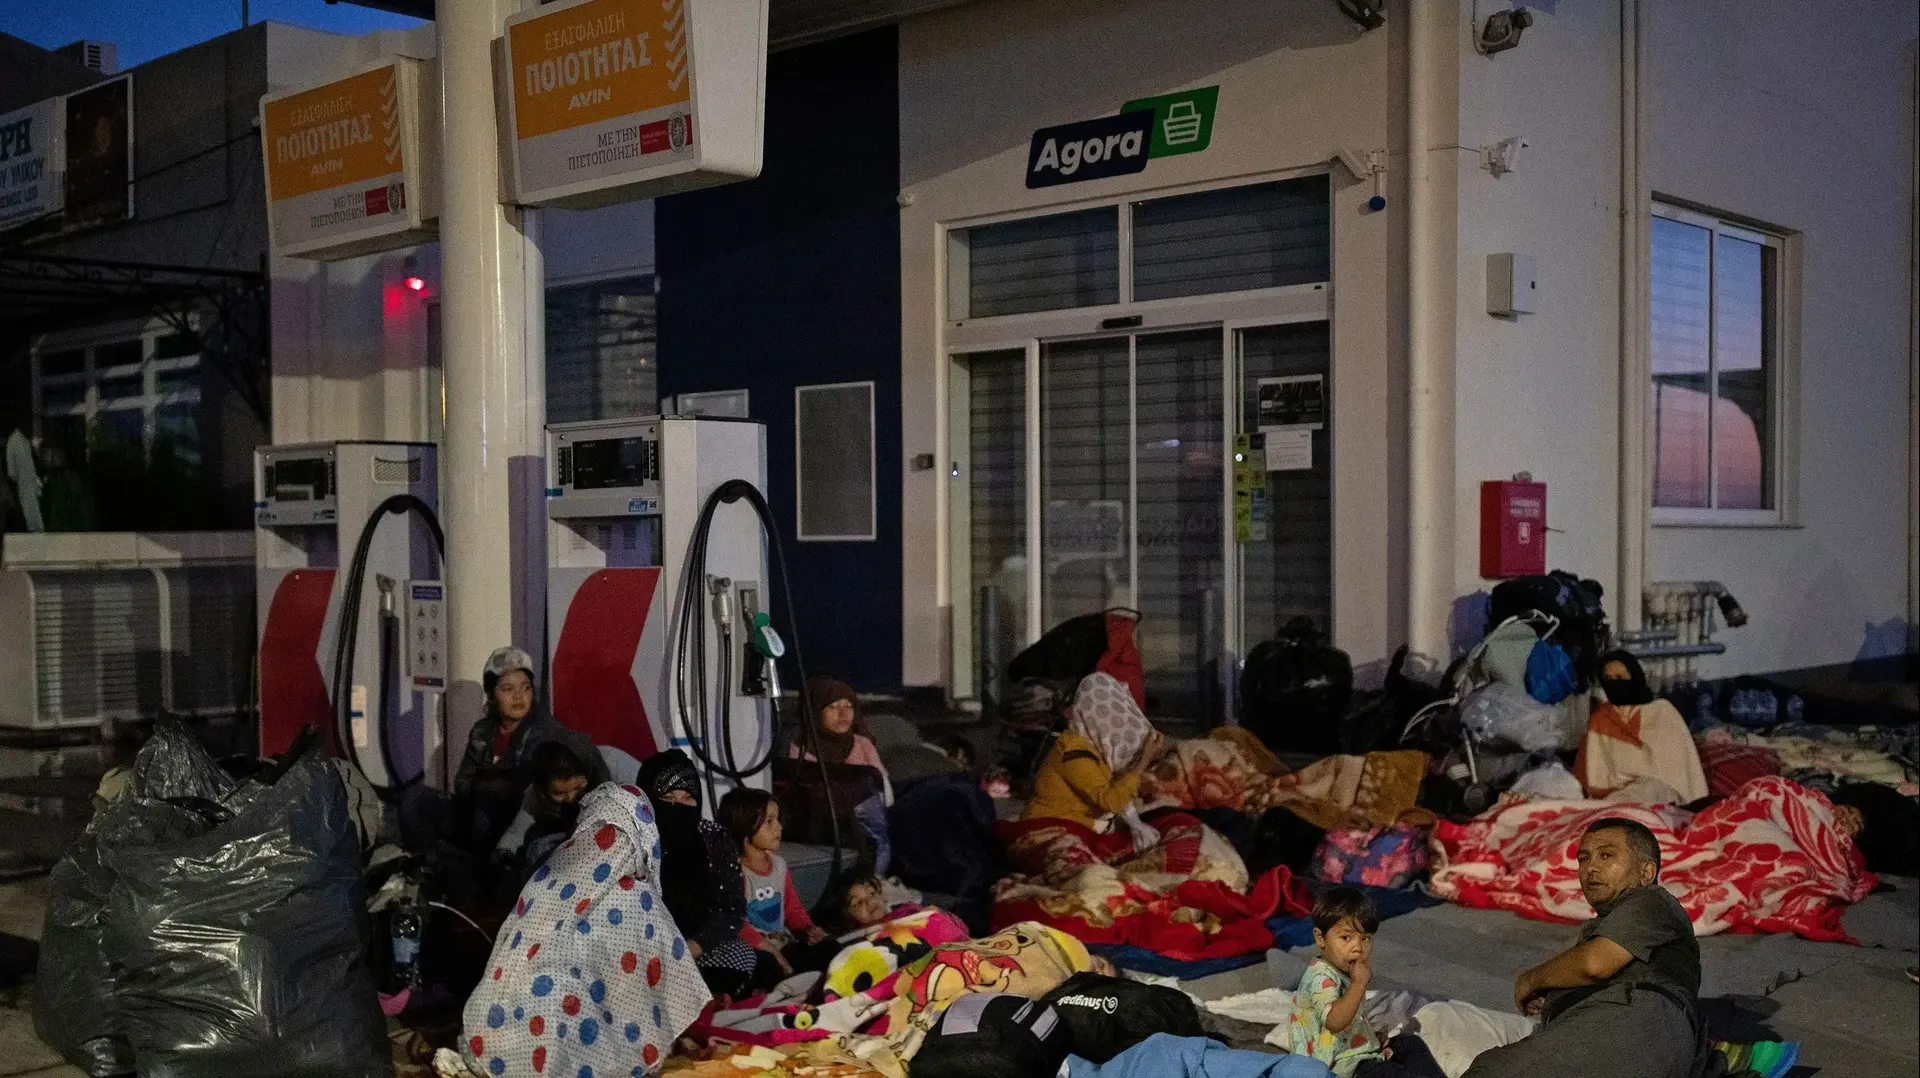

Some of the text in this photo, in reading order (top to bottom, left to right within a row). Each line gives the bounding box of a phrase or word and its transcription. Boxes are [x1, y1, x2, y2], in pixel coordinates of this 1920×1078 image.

[544, 13, 627, 51] ΕΞΑΣΦΑΛΙΣΗ
[526, 32, 652, 96] ΠΟΙΟΤΗΤΑΣ
[568, 86, 612, 111] AVIN
[275, 112, 373, 163] ΠΟΙΟΤΗΤΑΣ
[597, 132, 614, 148] ΜΕ
[615, 125, 638, 144] ΤΗΝ
[1033, 127, 1144, 176] Agora
[568, 144, 640, 171] ΠΙΣΤΟΠΟΙΗΣΗ
